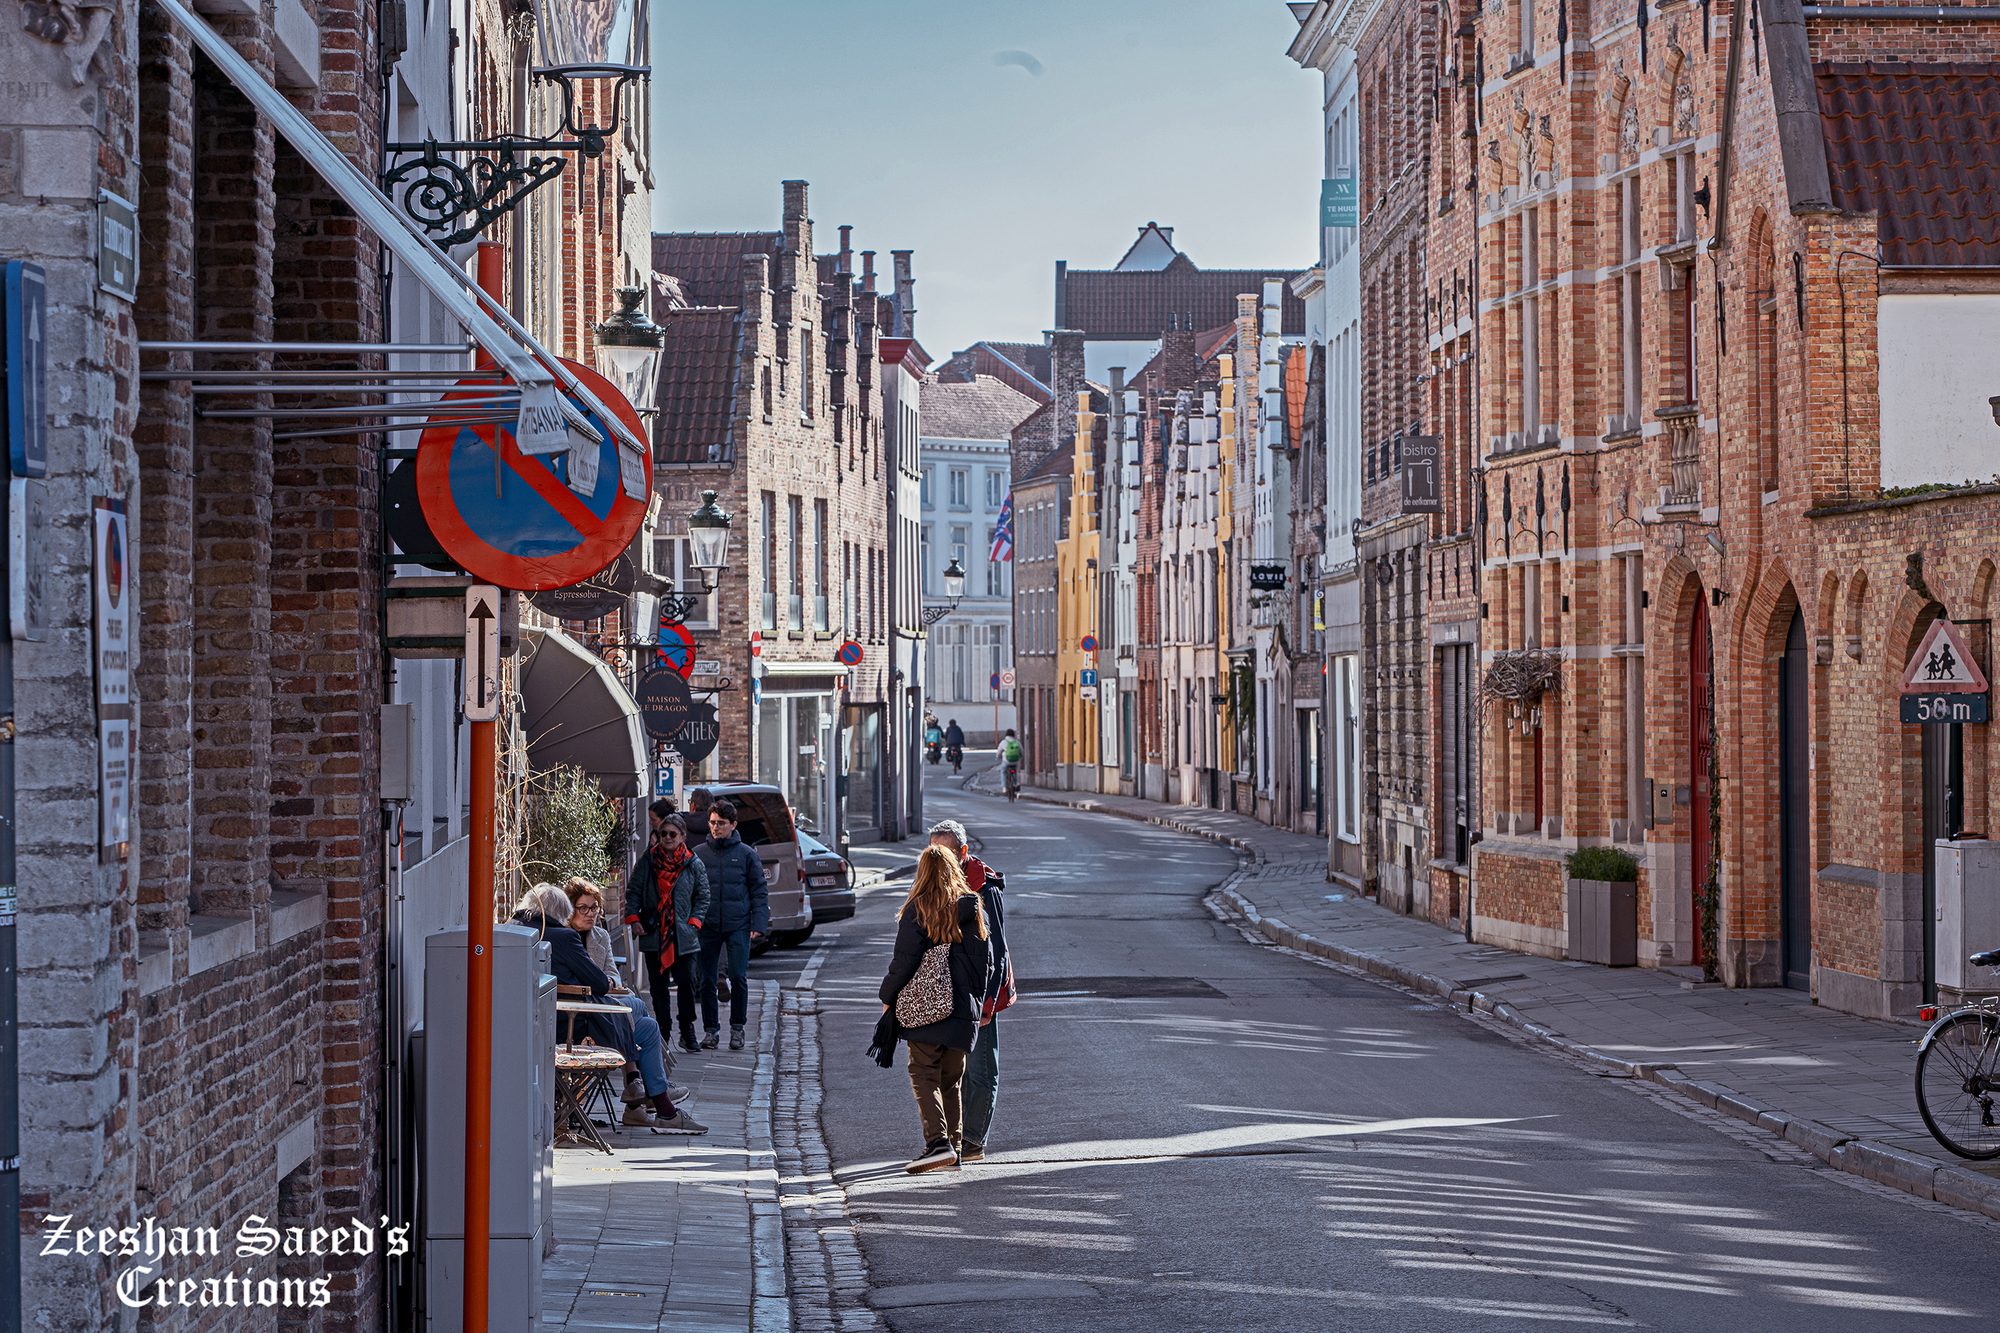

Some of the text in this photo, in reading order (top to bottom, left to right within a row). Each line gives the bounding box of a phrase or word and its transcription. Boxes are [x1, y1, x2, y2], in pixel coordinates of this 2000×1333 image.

[1402, 442, 1437, 457] bistro
[1403, 497, 1411, 506] de
[554, 590, 601, 600] Espressobar
[647, 695, 680, 703] MAISON
[652, 704, 688, 712] DRAGON
[659, 770, 670, 787] P
